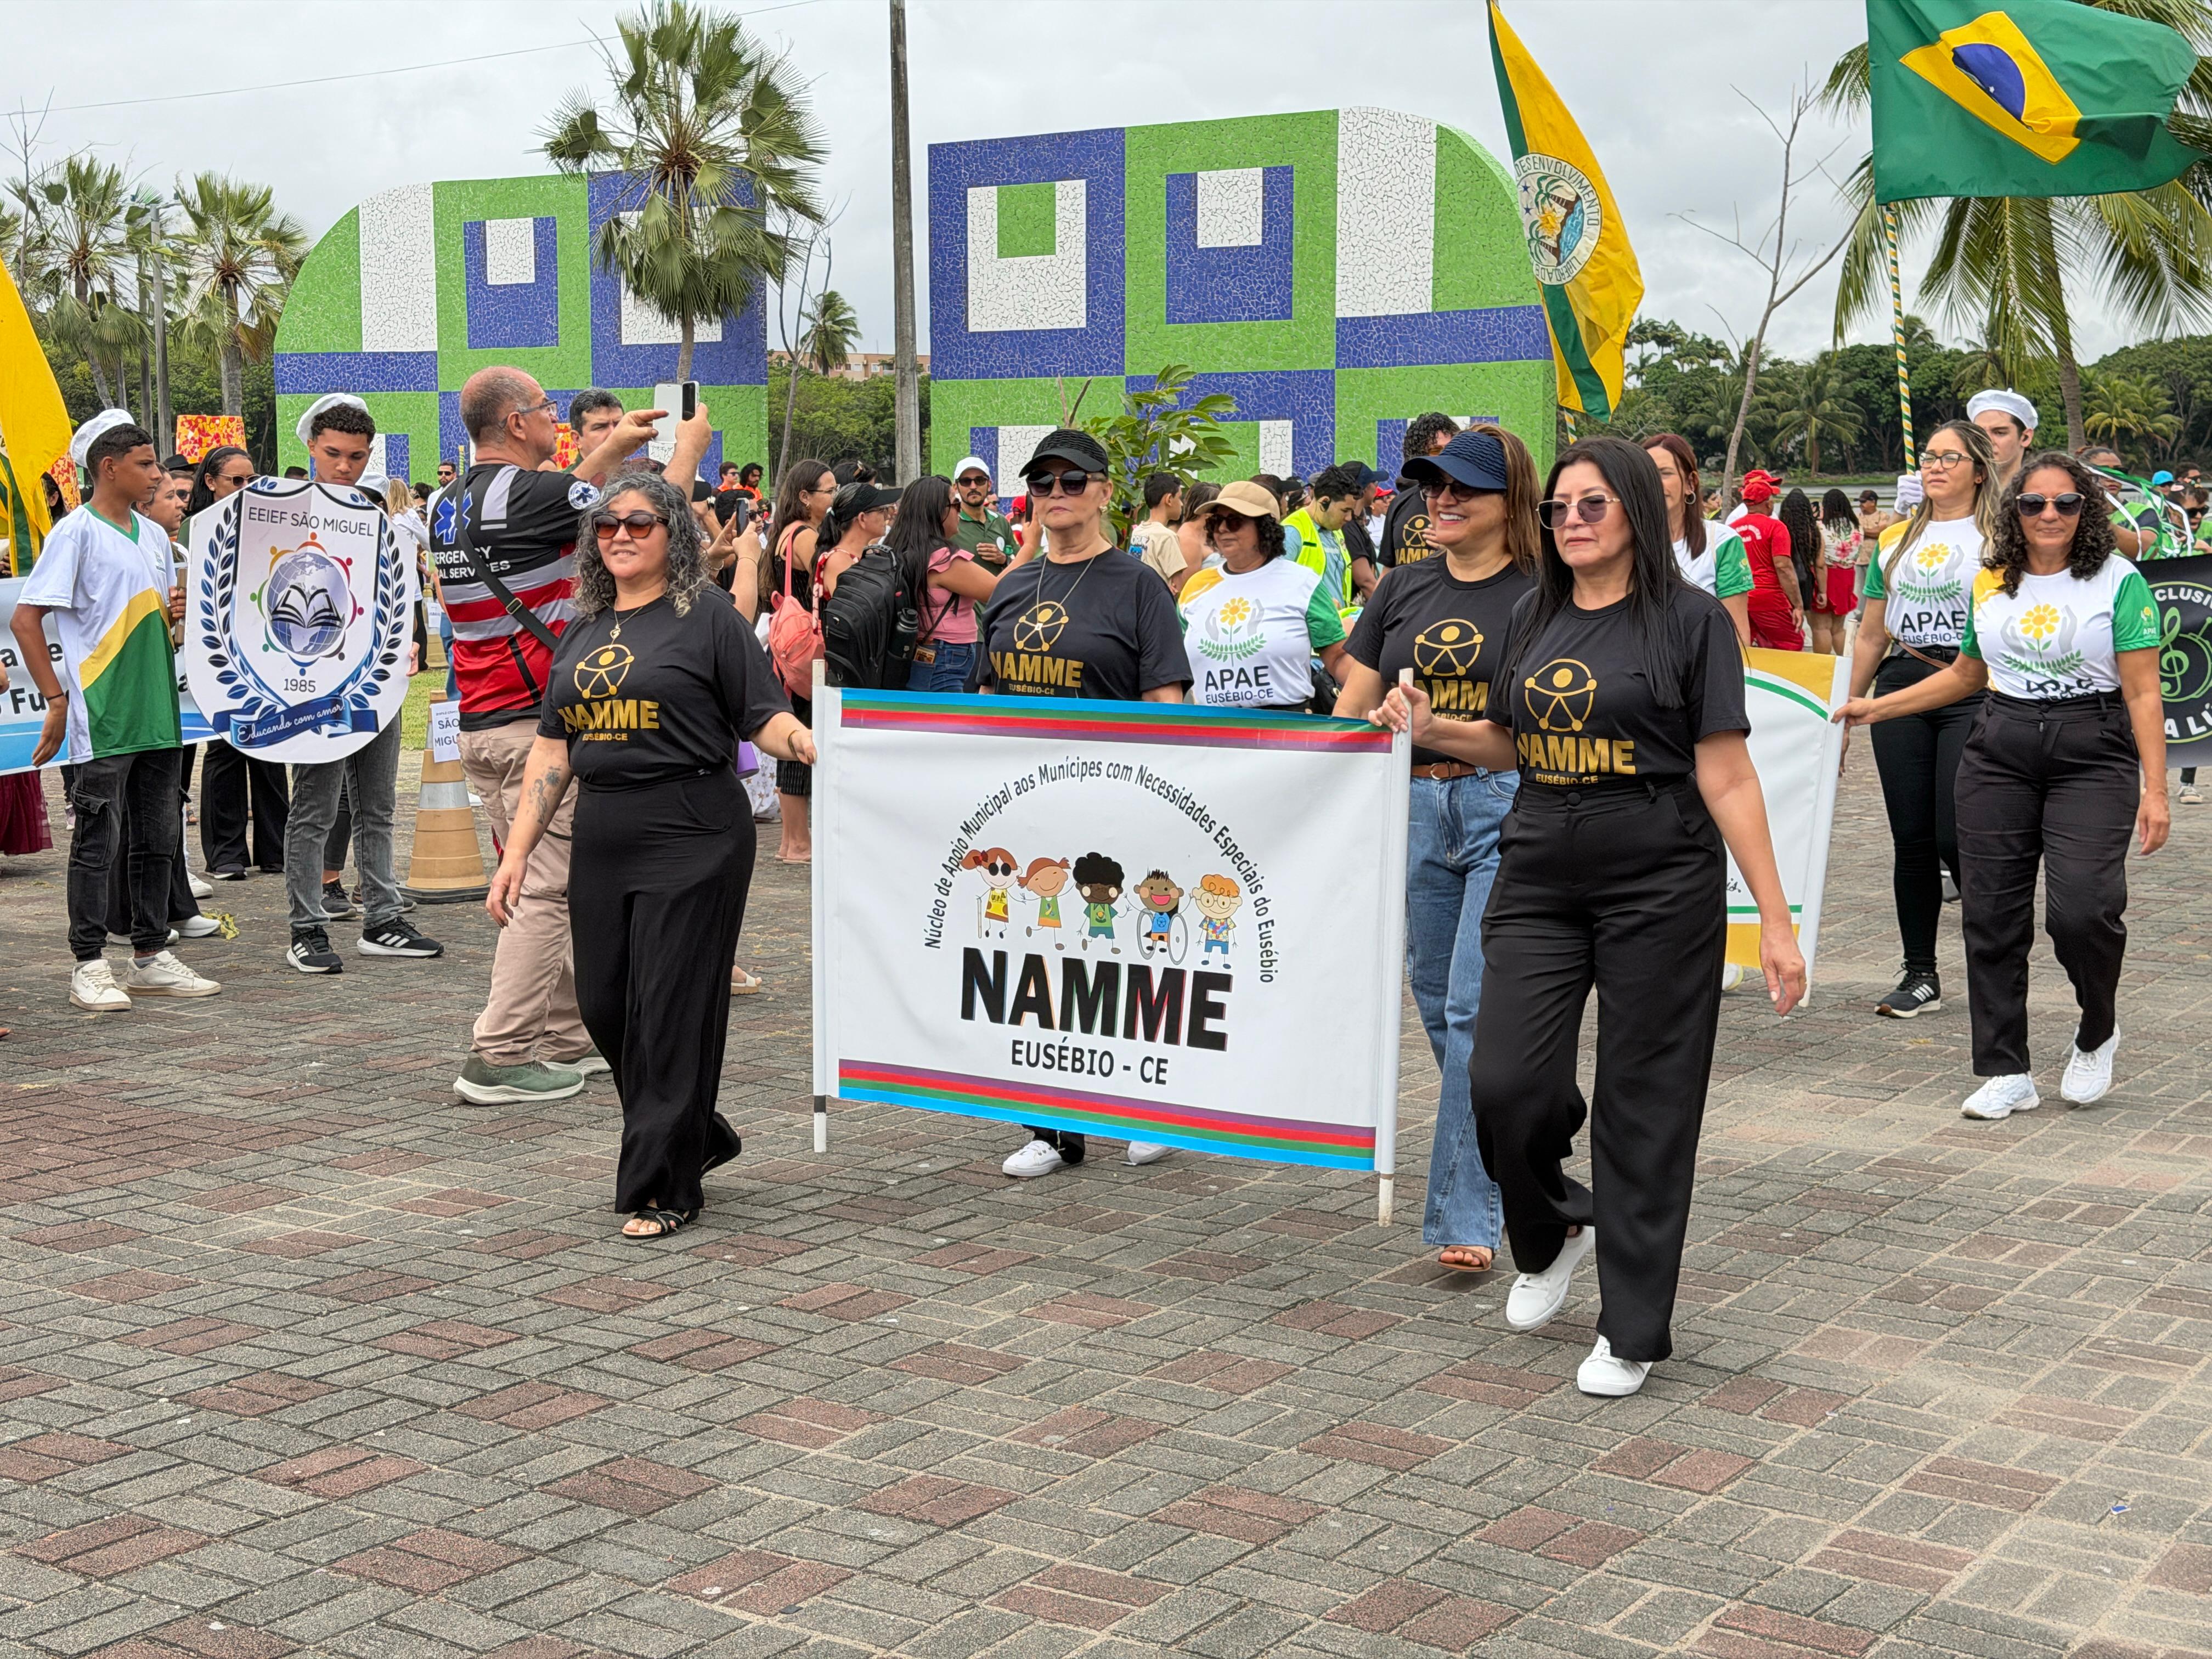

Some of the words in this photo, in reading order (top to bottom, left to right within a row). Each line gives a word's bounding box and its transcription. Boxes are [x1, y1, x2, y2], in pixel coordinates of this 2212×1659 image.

[1514, 156, 1599, 226] DESENVOLVIMENTO
[249, 507, 288, 524] EEIEF
[291, 512, 319, 528] SÃO
[323, 517, 374, 537] MIGUEL
[1901, 610, 1967, 633] APAE
[284, 678, 316, 692] 1985
[989, 651, 1084, 688] NAMME
[1205, 665, 1271, 692] APAE
[1206, 688, 1273, 703] EUSÉBIO-CE
[237, 714, 292, 742] Educando
[294, 714, 315, 726] com
[317, 703, 345, 718] amor!
[438, 717, 459, 730] SÃO
[557, 699, 659, 733] NAMME
[1038, 756, 1102, 785] Munícipes
[1517, 733, 1636, 774] NAMME
[1014, 774, 1036, 796] aos
[1106, 763, 1132, 782] com
[960, 782, 1013, 840] Municipal
[1135, 764, 1217, 834] Necessidades
[941, 838, 969, 877] Apoio
[1213, 825, 1265, 895] Especiais
[934, 877, 952, 896] de
[924, 900, 947, 949] Núcleo
[1254, 897, 1272, 917] do
[1258, 919, 1280, 983] Eusébio
[961, 947, 1233, 1052] NAMME
[1012, 1036, 1114, 1077] EUSÉBIO
[1140, 1056, 1169, 1085] CE
